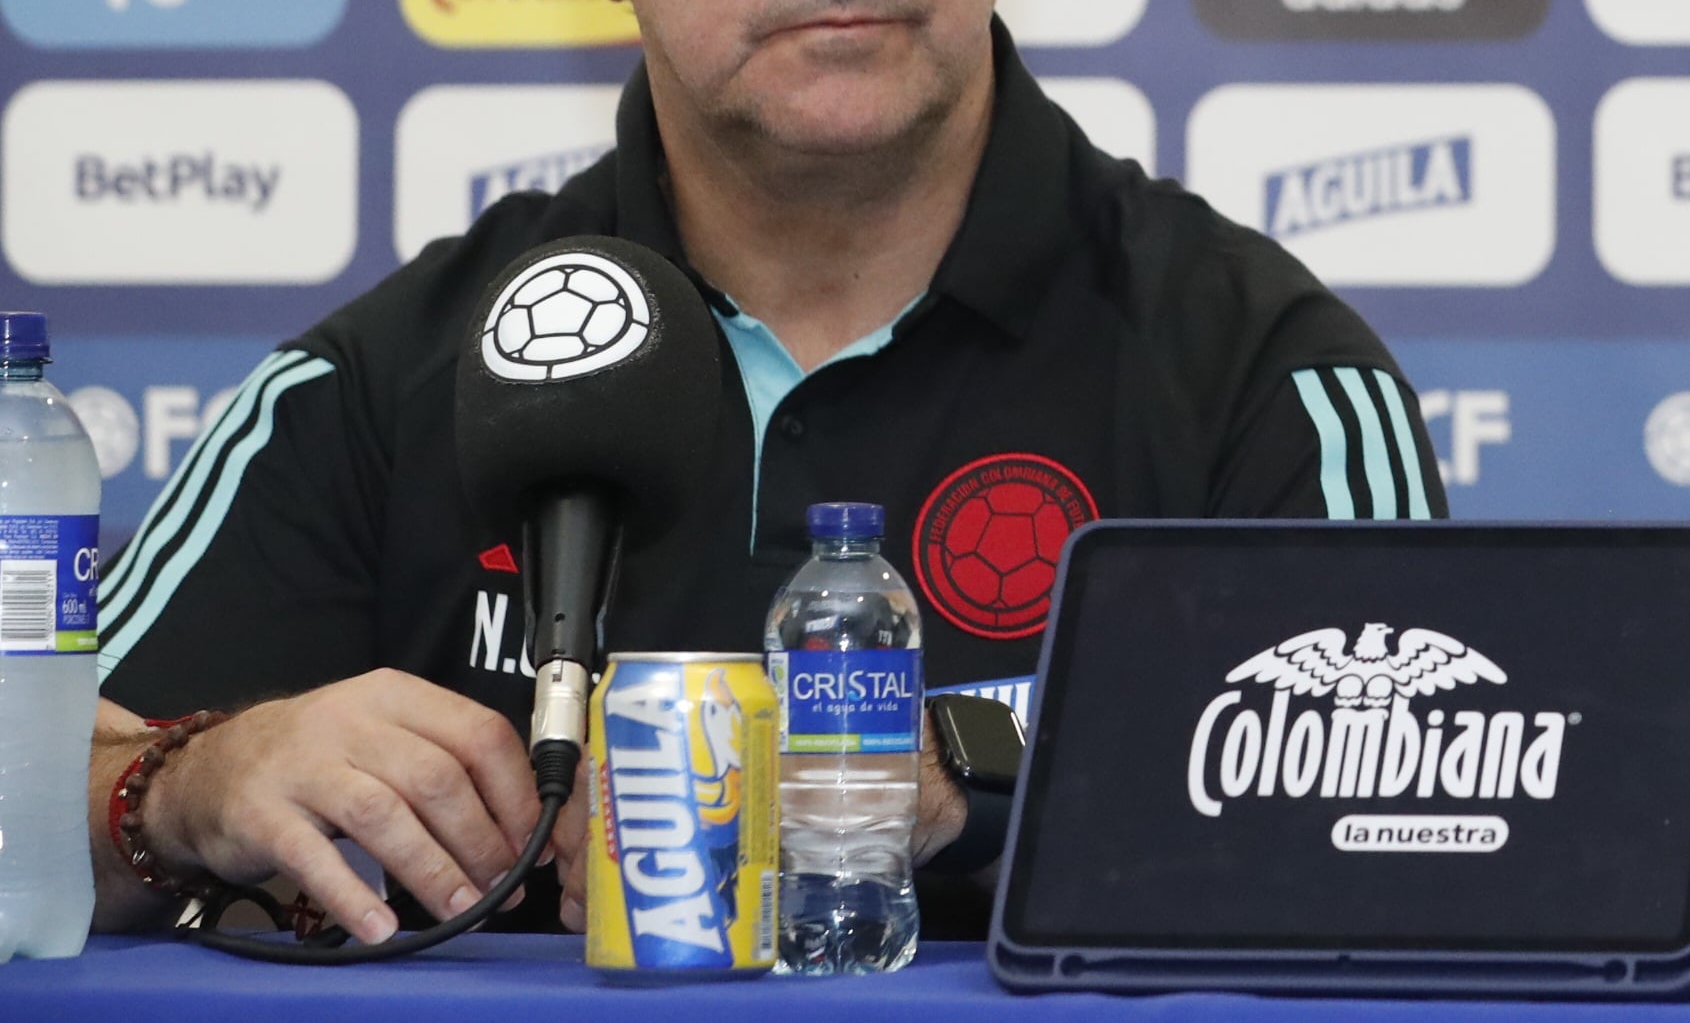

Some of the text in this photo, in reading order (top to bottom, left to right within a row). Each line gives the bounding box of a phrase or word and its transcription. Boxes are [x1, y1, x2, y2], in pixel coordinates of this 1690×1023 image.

[76, 152, 280, 214] BetPlay
[1270, 138, 1468, 236] AGUILA
[793, 670, 912, 701] CRISTAL
[827, 703, 856, 716] agua
[860, 701, 873, 712] de
[605, 670, 726, 954] AGUILA
[1344, 824, 1498, 845] la nuestra
